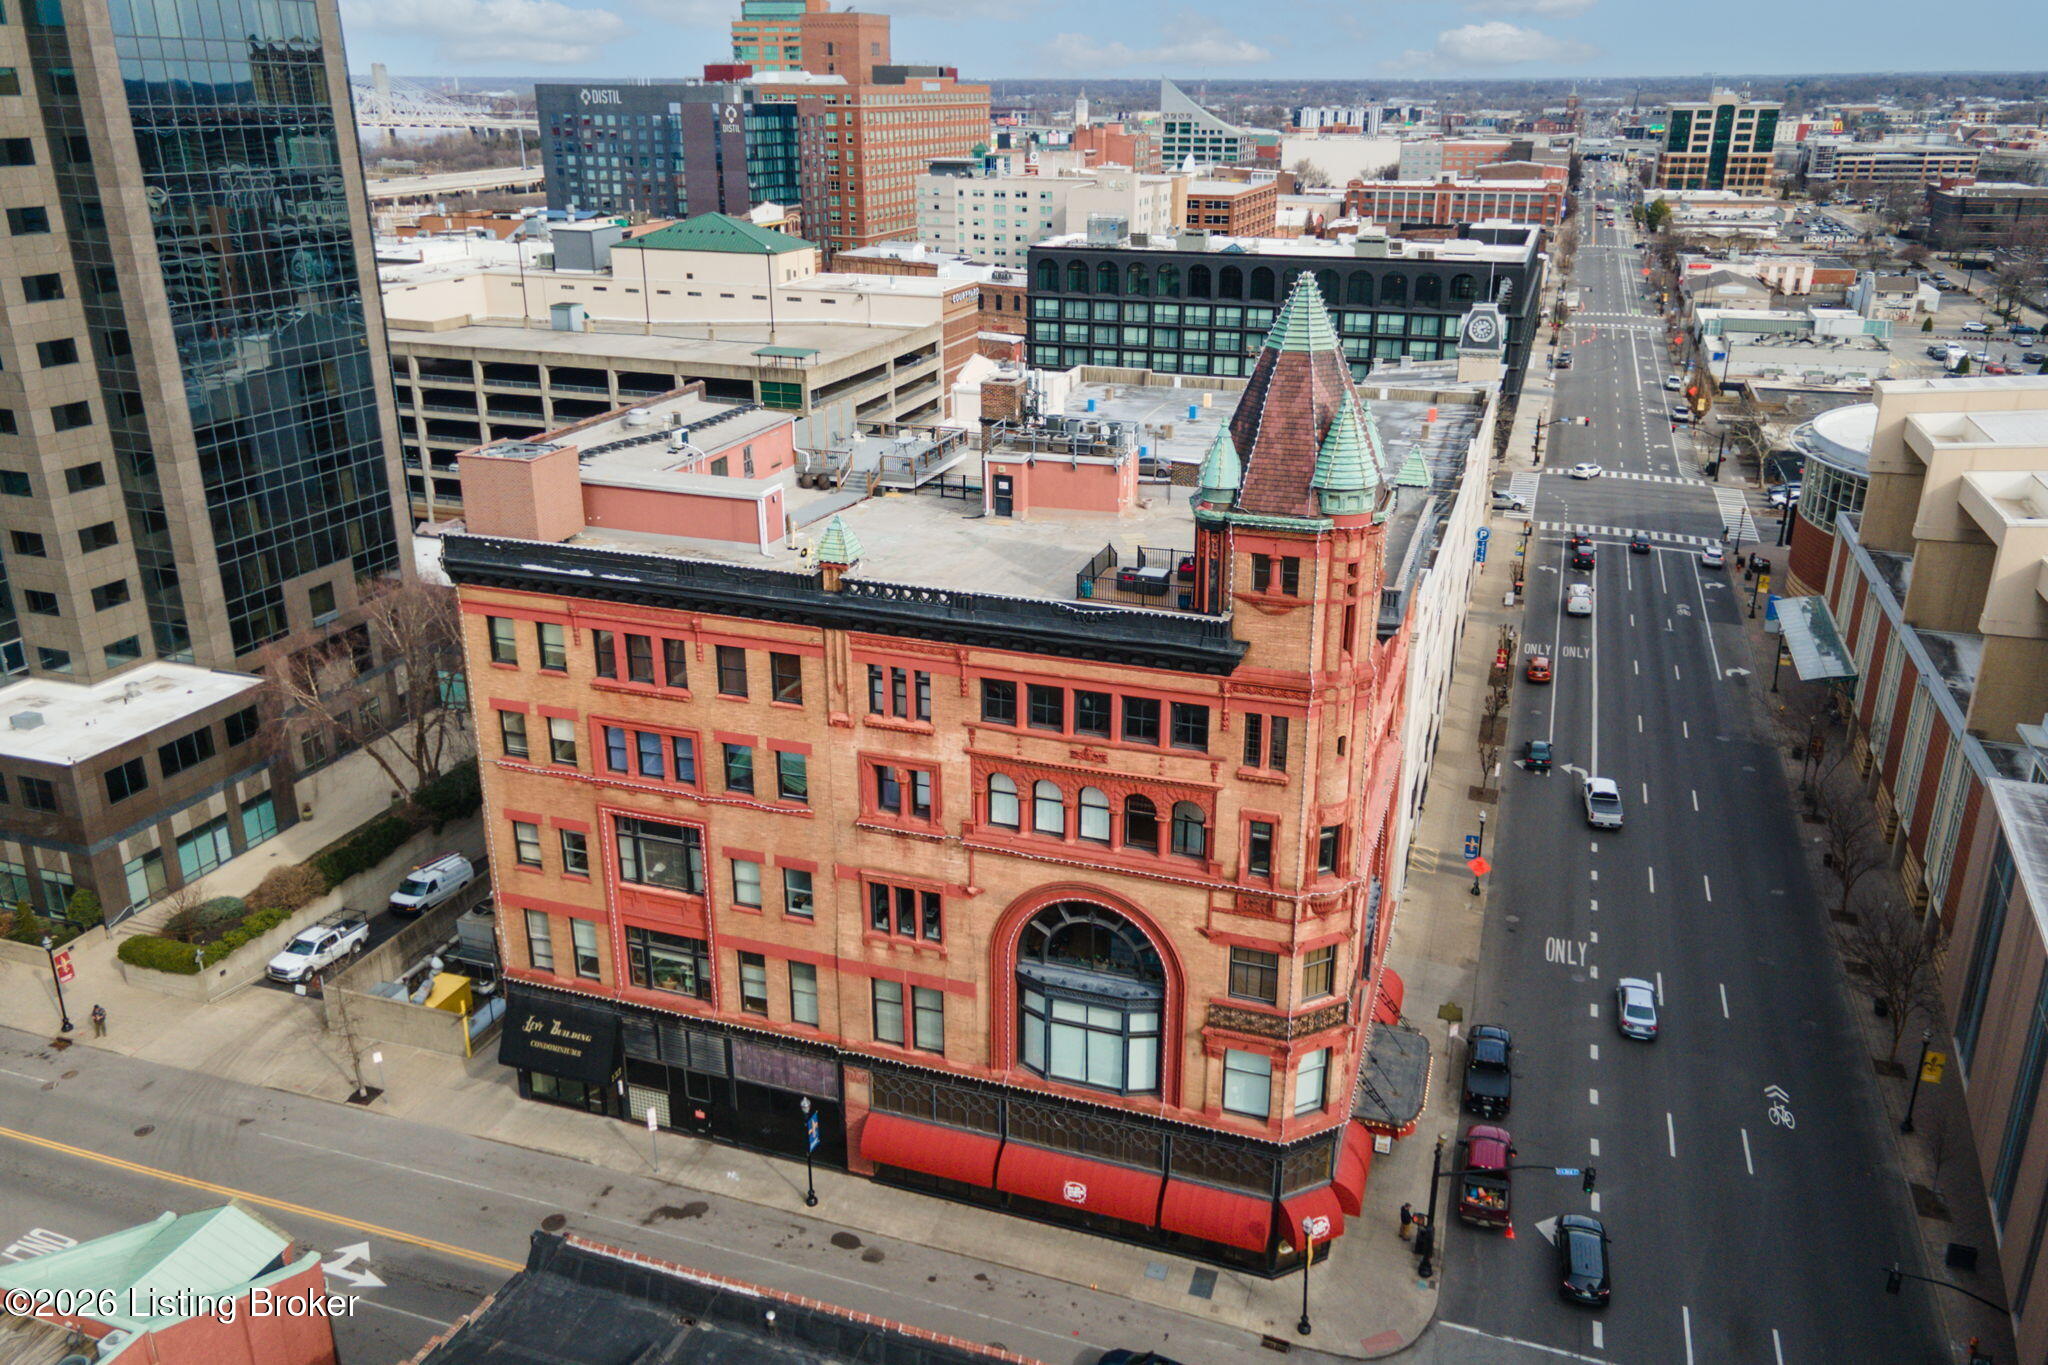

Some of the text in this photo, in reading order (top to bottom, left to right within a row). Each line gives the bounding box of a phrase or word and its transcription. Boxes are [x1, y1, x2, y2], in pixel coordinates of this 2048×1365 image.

[592, 90, 622, 104] DISTIL
[722, 124, 741, 133] DISTIL
[1803, 235, 1858, 243] LIQUOR BARN
[1524, 643, 1552, 656] ONLY
[1562, 646, 1590, 659] ONLY
[1546, 936, 1587, 967] ONLY
[530, 1040, 582, 1057] CONDOMINIUMS
